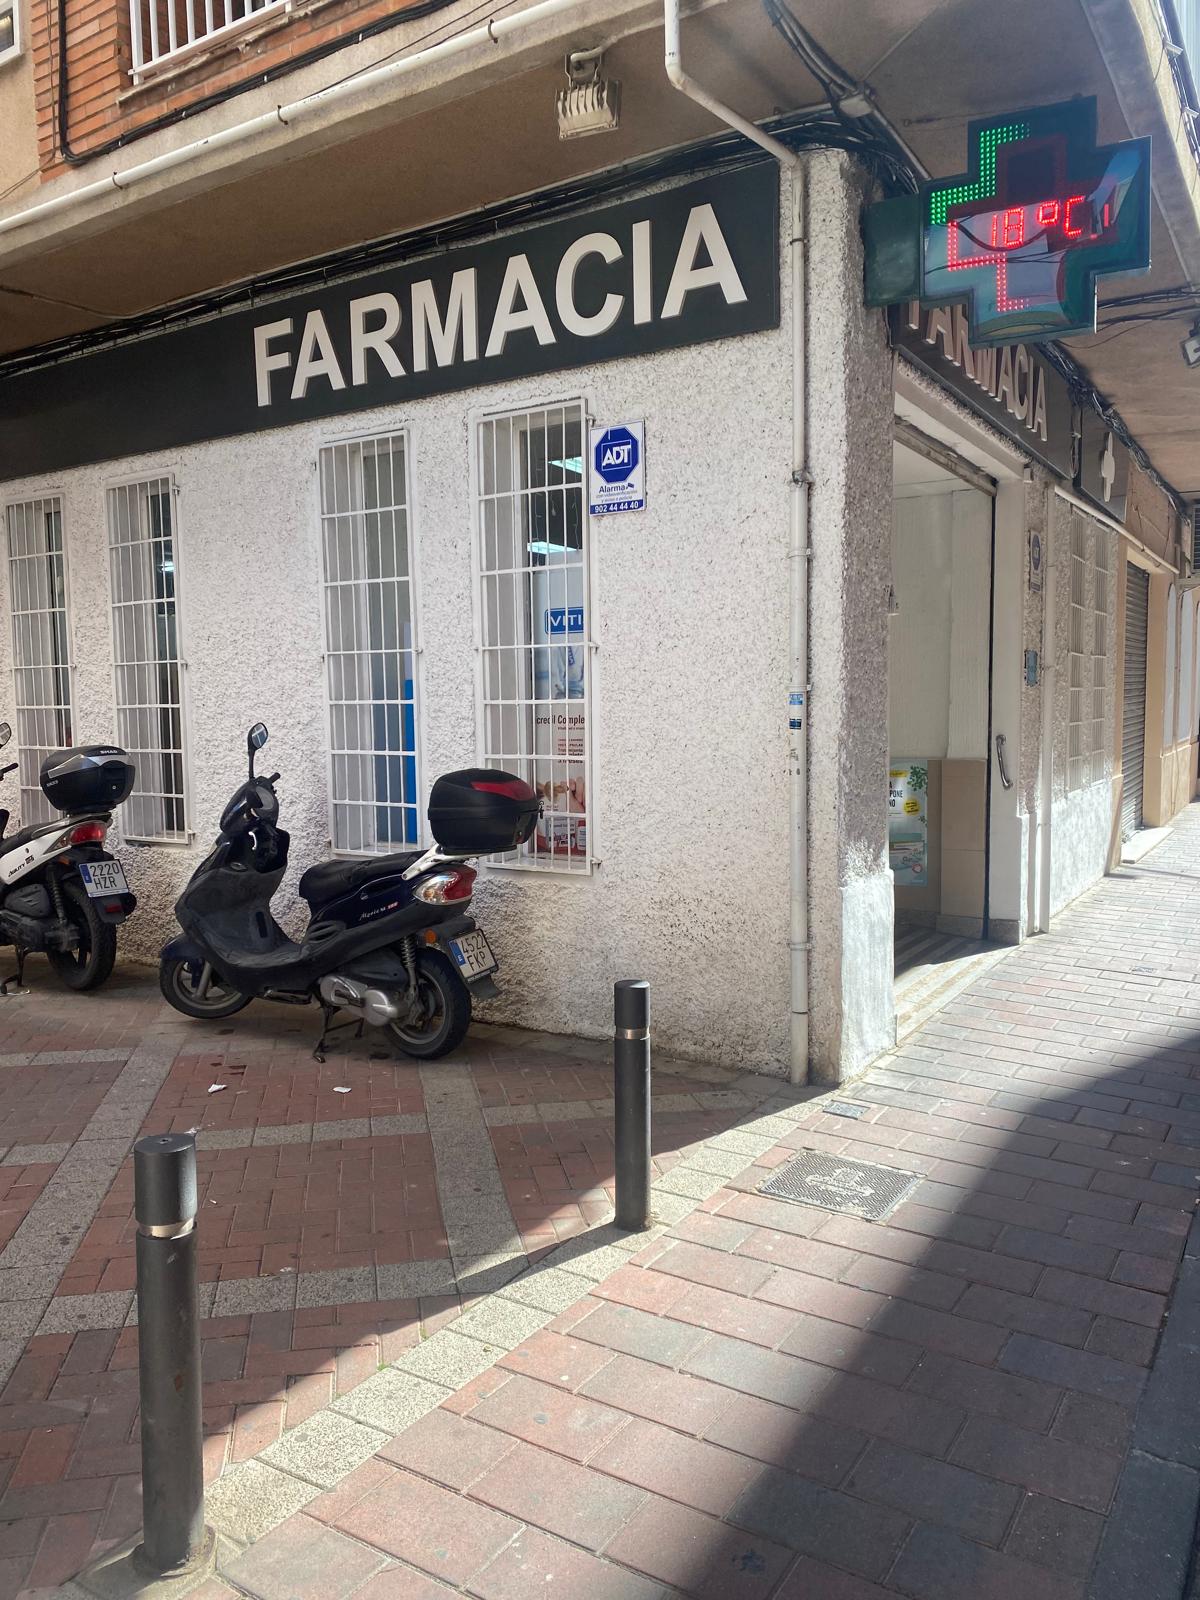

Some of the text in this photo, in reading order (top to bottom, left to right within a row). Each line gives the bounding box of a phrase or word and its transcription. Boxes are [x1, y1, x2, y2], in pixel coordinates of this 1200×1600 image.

[990, 206, 1024, 250] 18
[253, 203, 748, 407] FARMACIA
[909, 299, 1048, 442] ARMACIA
[602, 444, 632, 466] ADT
[599, 484, 626, 494] Alarma
[594, 500, 639, 513] 902 44 44 40
[90, 863, 120, 877] 2220
[94, 875, 118, 890] HZR
[460, 934, 486, 953] 4522
[467, 951, 486, 971] FKP
